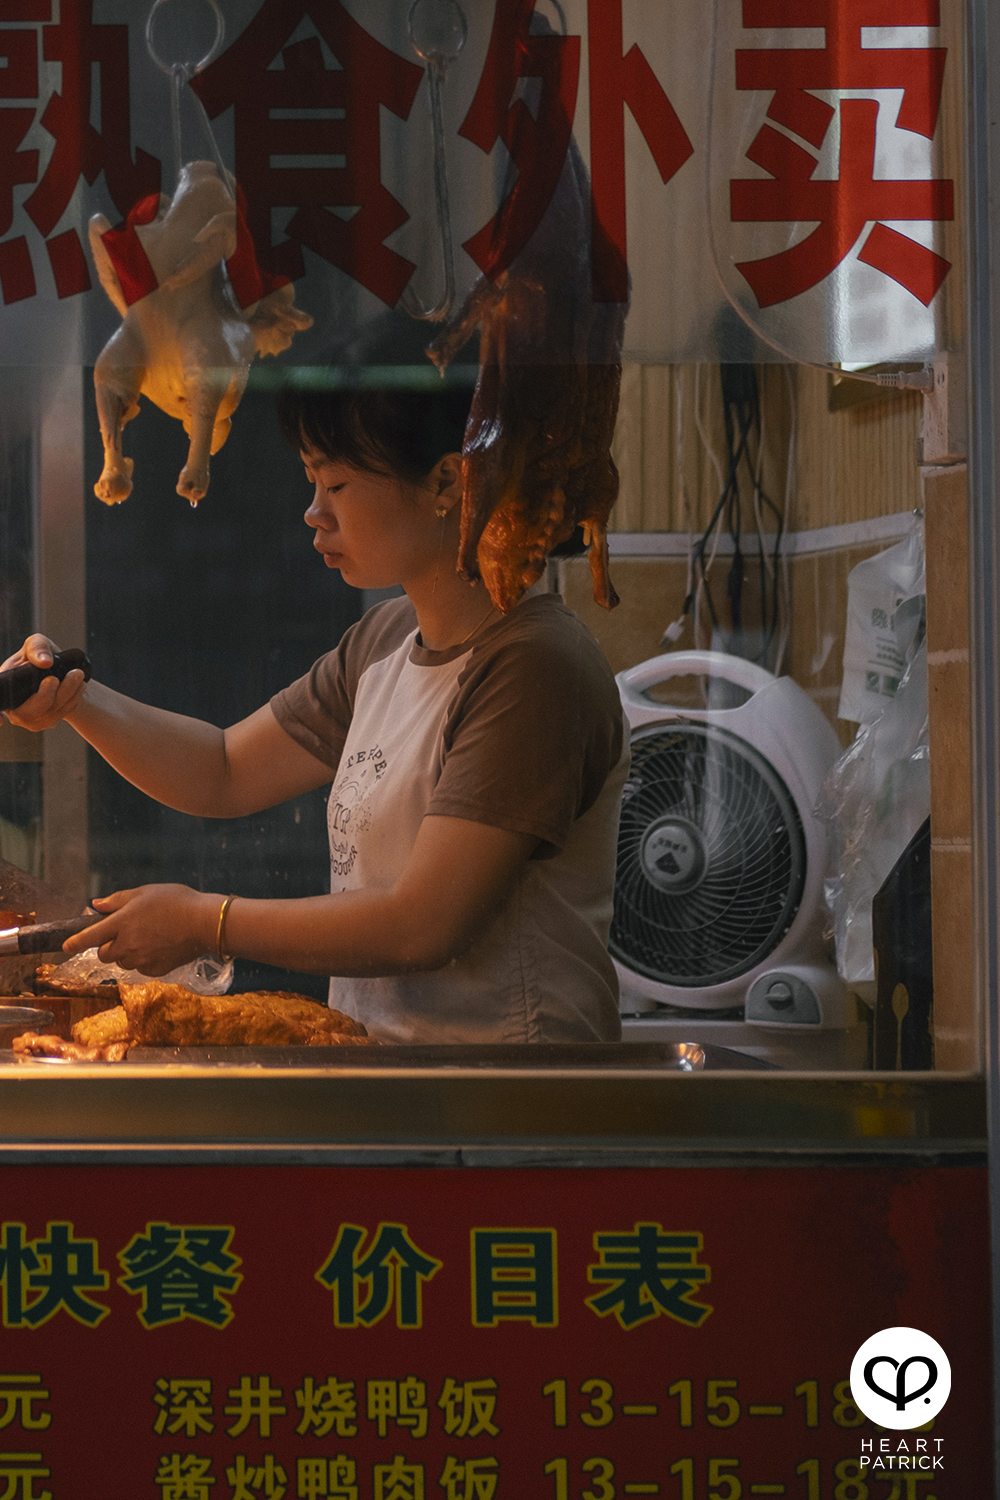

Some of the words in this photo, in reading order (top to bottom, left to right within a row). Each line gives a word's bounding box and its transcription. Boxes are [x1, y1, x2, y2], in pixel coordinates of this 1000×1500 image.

[315, 1221, 714, 1330] 价目表
[153, 1376, 501, 1438] 深井烧鸭饭
[541, 1378, 936, 1433] 13-15-18
[154, 1454, 501, 1500] 酱炒鸭肉饭
